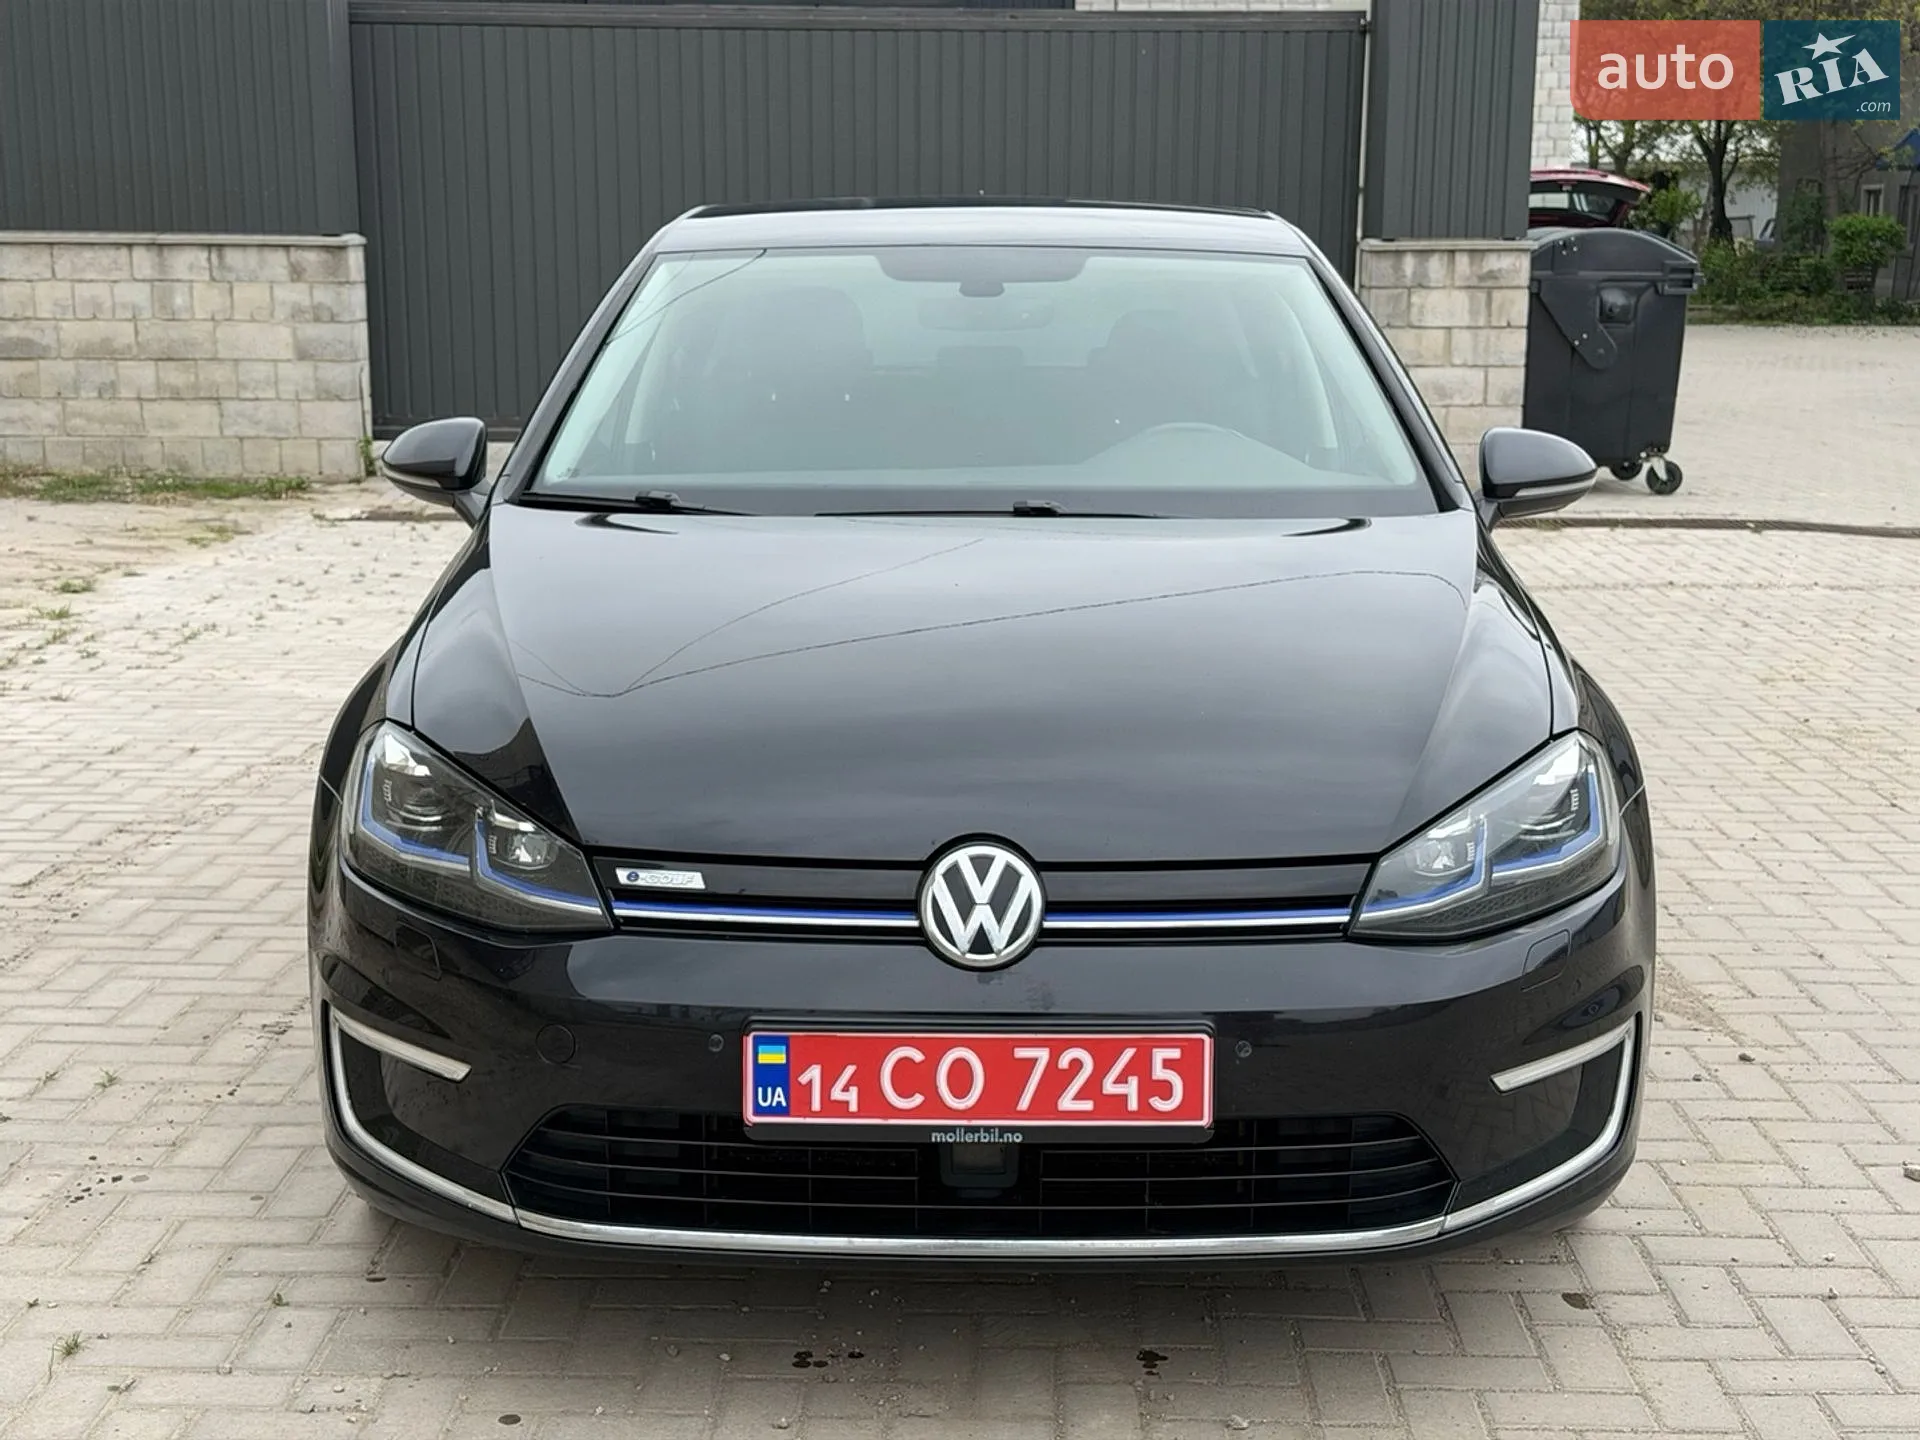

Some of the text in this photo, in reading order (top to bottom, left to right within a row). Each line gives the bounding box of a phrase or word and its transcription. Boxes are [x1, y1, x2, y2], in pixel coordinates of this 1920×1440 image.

[798, 1046, 1185, 1113] 14 CO 7245
[757, 1086, 787, 1108] UA
[931, 1127, 1024, 1144] mollerbil.no
